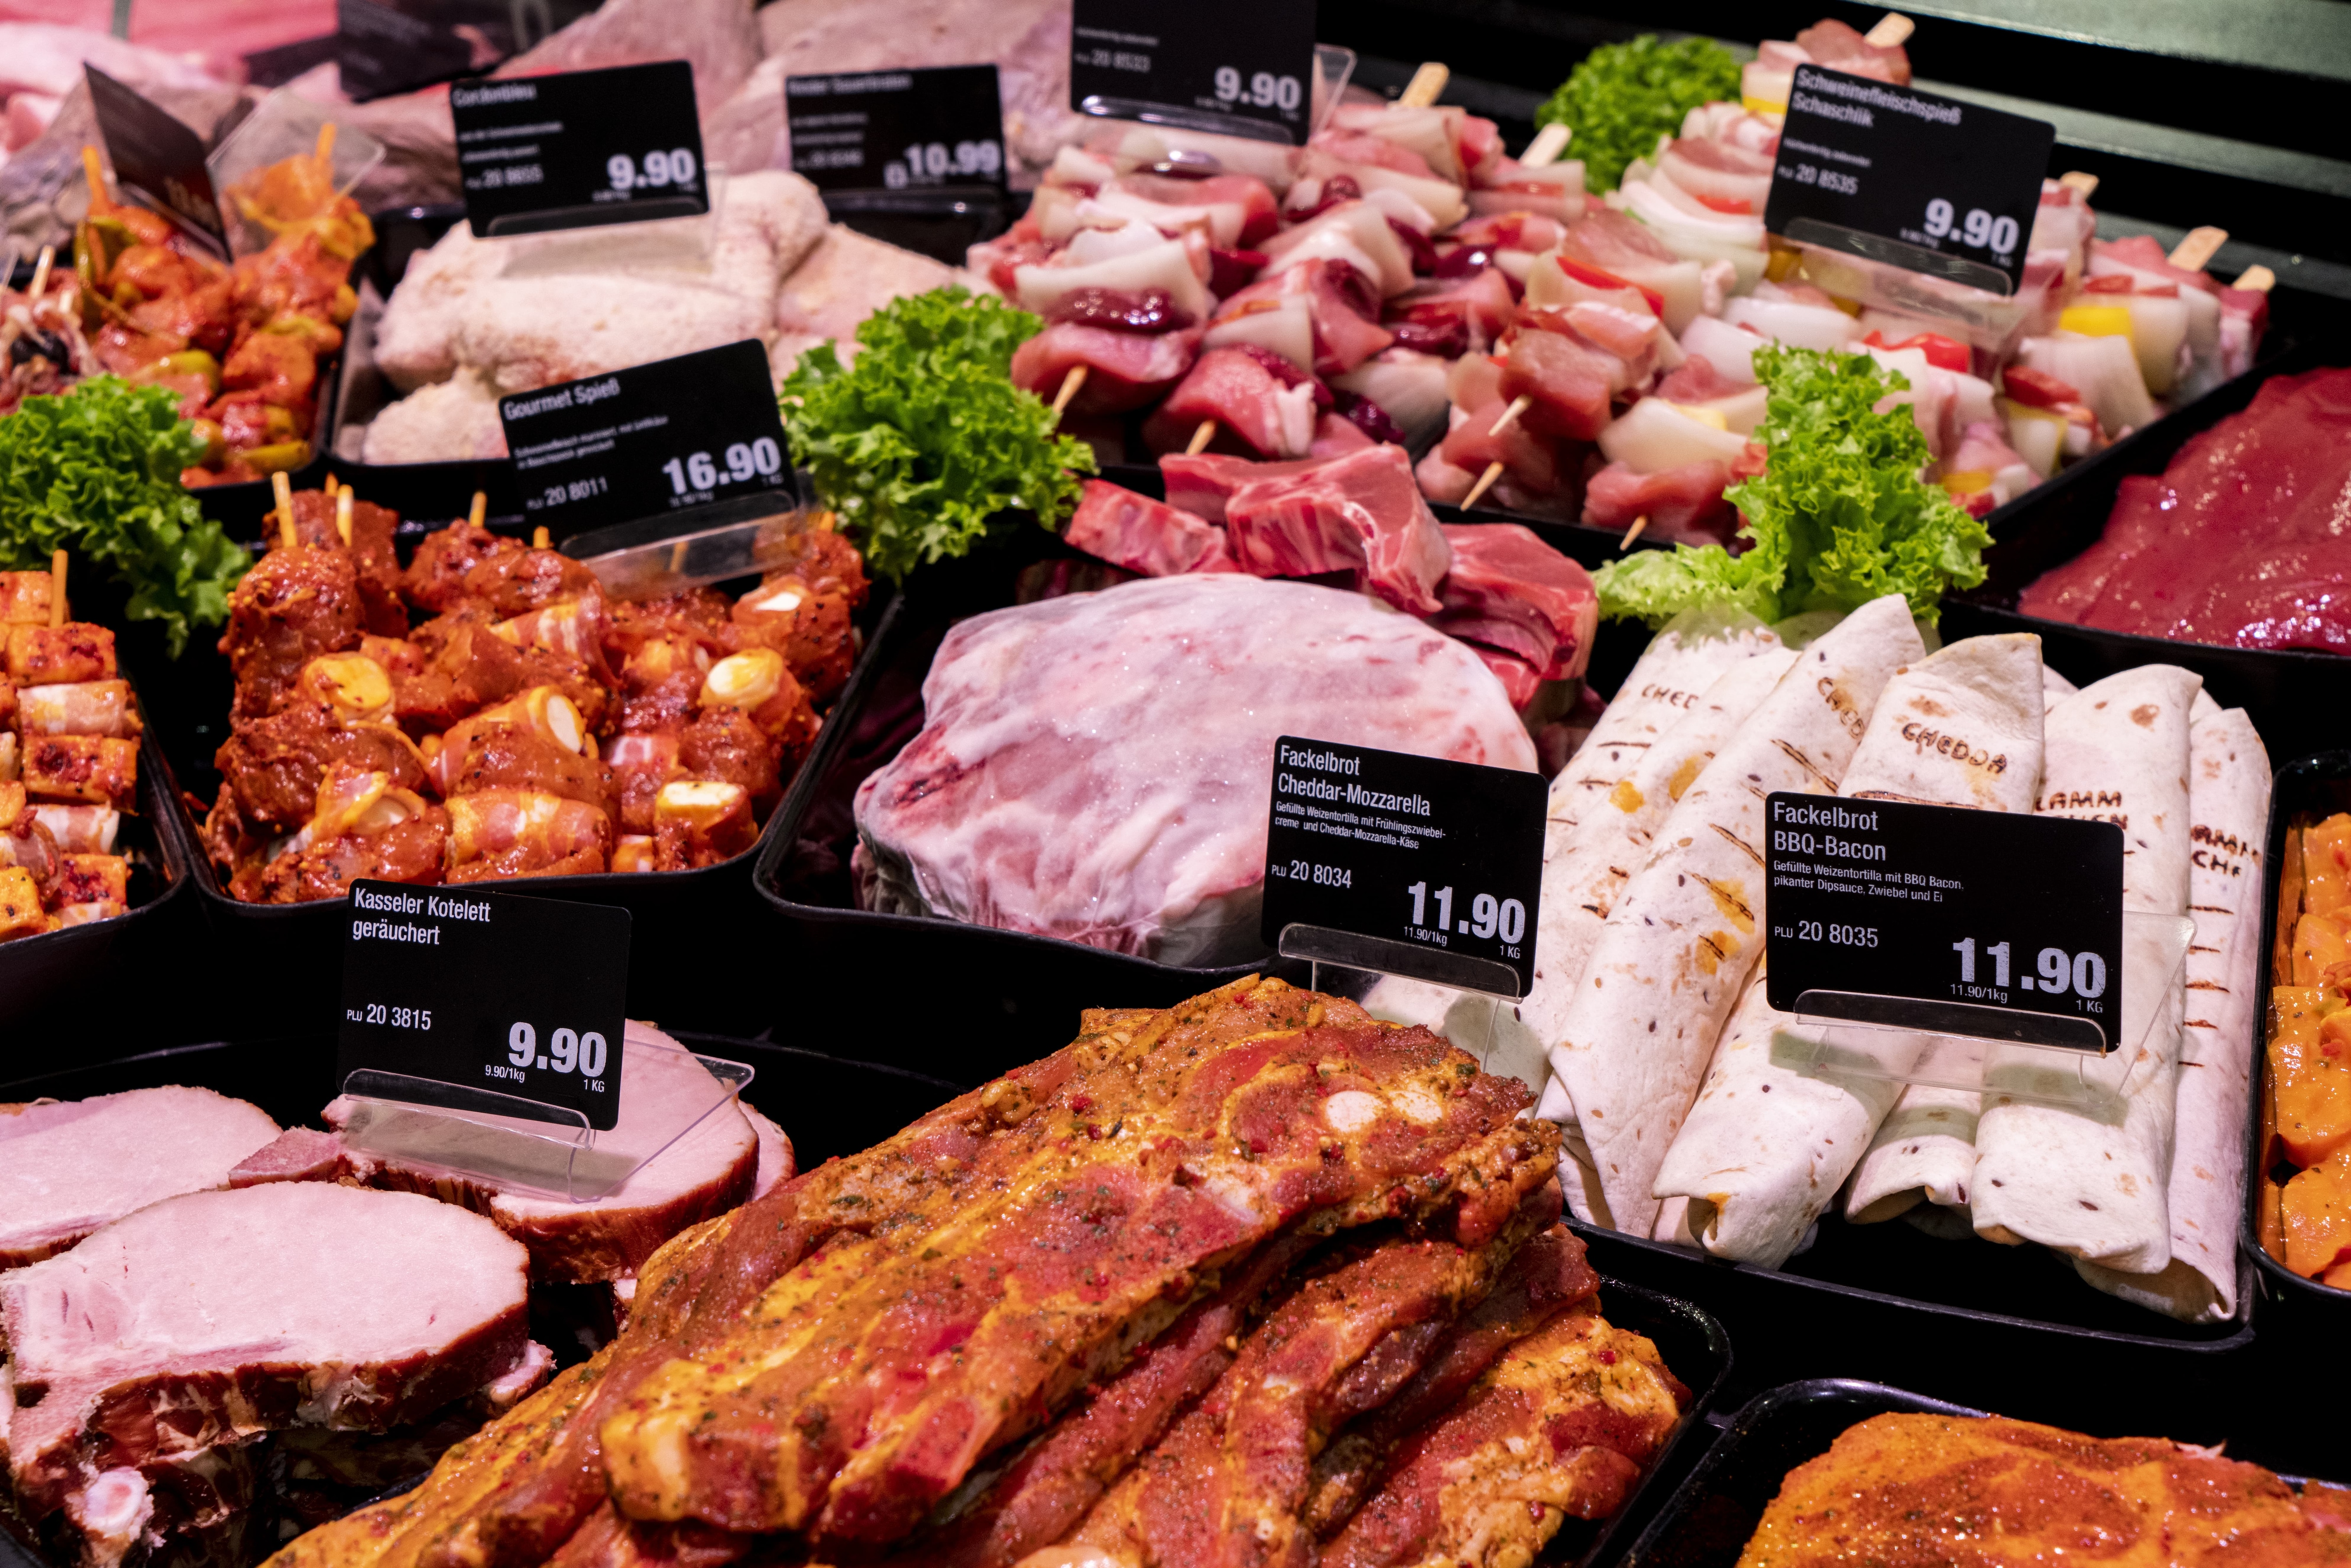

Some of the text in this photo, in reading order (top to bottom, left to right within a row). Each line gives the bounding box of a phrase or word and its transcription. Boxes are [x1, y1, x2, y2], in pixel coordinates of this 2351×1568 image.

[1091, 48, 1112, 67] 20
[1214, 66, 1302, 110] 9.90
[1797, 68, 1962, 126] Schweinefleischspieß
[1792, 91, 1874, 127] Schaschlik
[607, 148, 697, 190] 9.90
[1795, 163, 1817, 184] 20
[1818, 169, 1859, 195] 8535
[1924, 198, 2020, 254] 9.90
[504, 378, 621, 421] Gourmet Spieß
[662, 436, 781, 496] 16.90
[544, 485, 567, 507] 20
[568, 476, 608, 501] 8011
[1280, 745, 1360, 776] Fackelbrot
[1278, 773, 1430, 816] Cheddar-Mozzarella
[1276, 801, 1446, 839] Gefüllte Weizentortilla mit Frühlingszwiebel-
[1774, 802, 1878, 831] Fackelbrot
[1275, 817, 1420, 850] creme und Cheddar-Mozzarella-Käse
[1775, 830, 1886, 861] BBQ-Bacon
[1272, 860, 1351, 888] PLU 20 8034
[1774, 860, 1811, 875] Gefüllte
[1814, 864, 1882, 882] Weizentortilla
[1885, 870, 1901, 882] mit
[1904, 873, 1926, 887] BBQ
[1774, 875, 1815, 889] pikanter
[1868, 884, 1908, 899] Zwiebel
[1911, 889, 1930, 901] und
[1933, 890, 1943, 902] Ei
[355, 888, 491, 922] Kasseler Kotelett
[1408, 881, 1526, 944] 11.90
[353, 919, 441, 945] geräuchert
[1404, 926, 1447, 946] 11.90/1kg
[1775, 920, 1878, 948] PLU 20 8035
[1500, 945, 1521, 960] 1 KG
[1952, 937, 2106, 998] 11.90
[1949, 983, 2008, 1004] 11.90/1kg
[2076, 1000, 2103, 1014] 1 KG
[347, 1004, 432, 1030] PLU 20 3815
[509, 1022, 607, 1077] 9.90
[485, 1065, 525, 1083] 9.90/1kg
[584, 1079, 605, 1093] 1 KG
